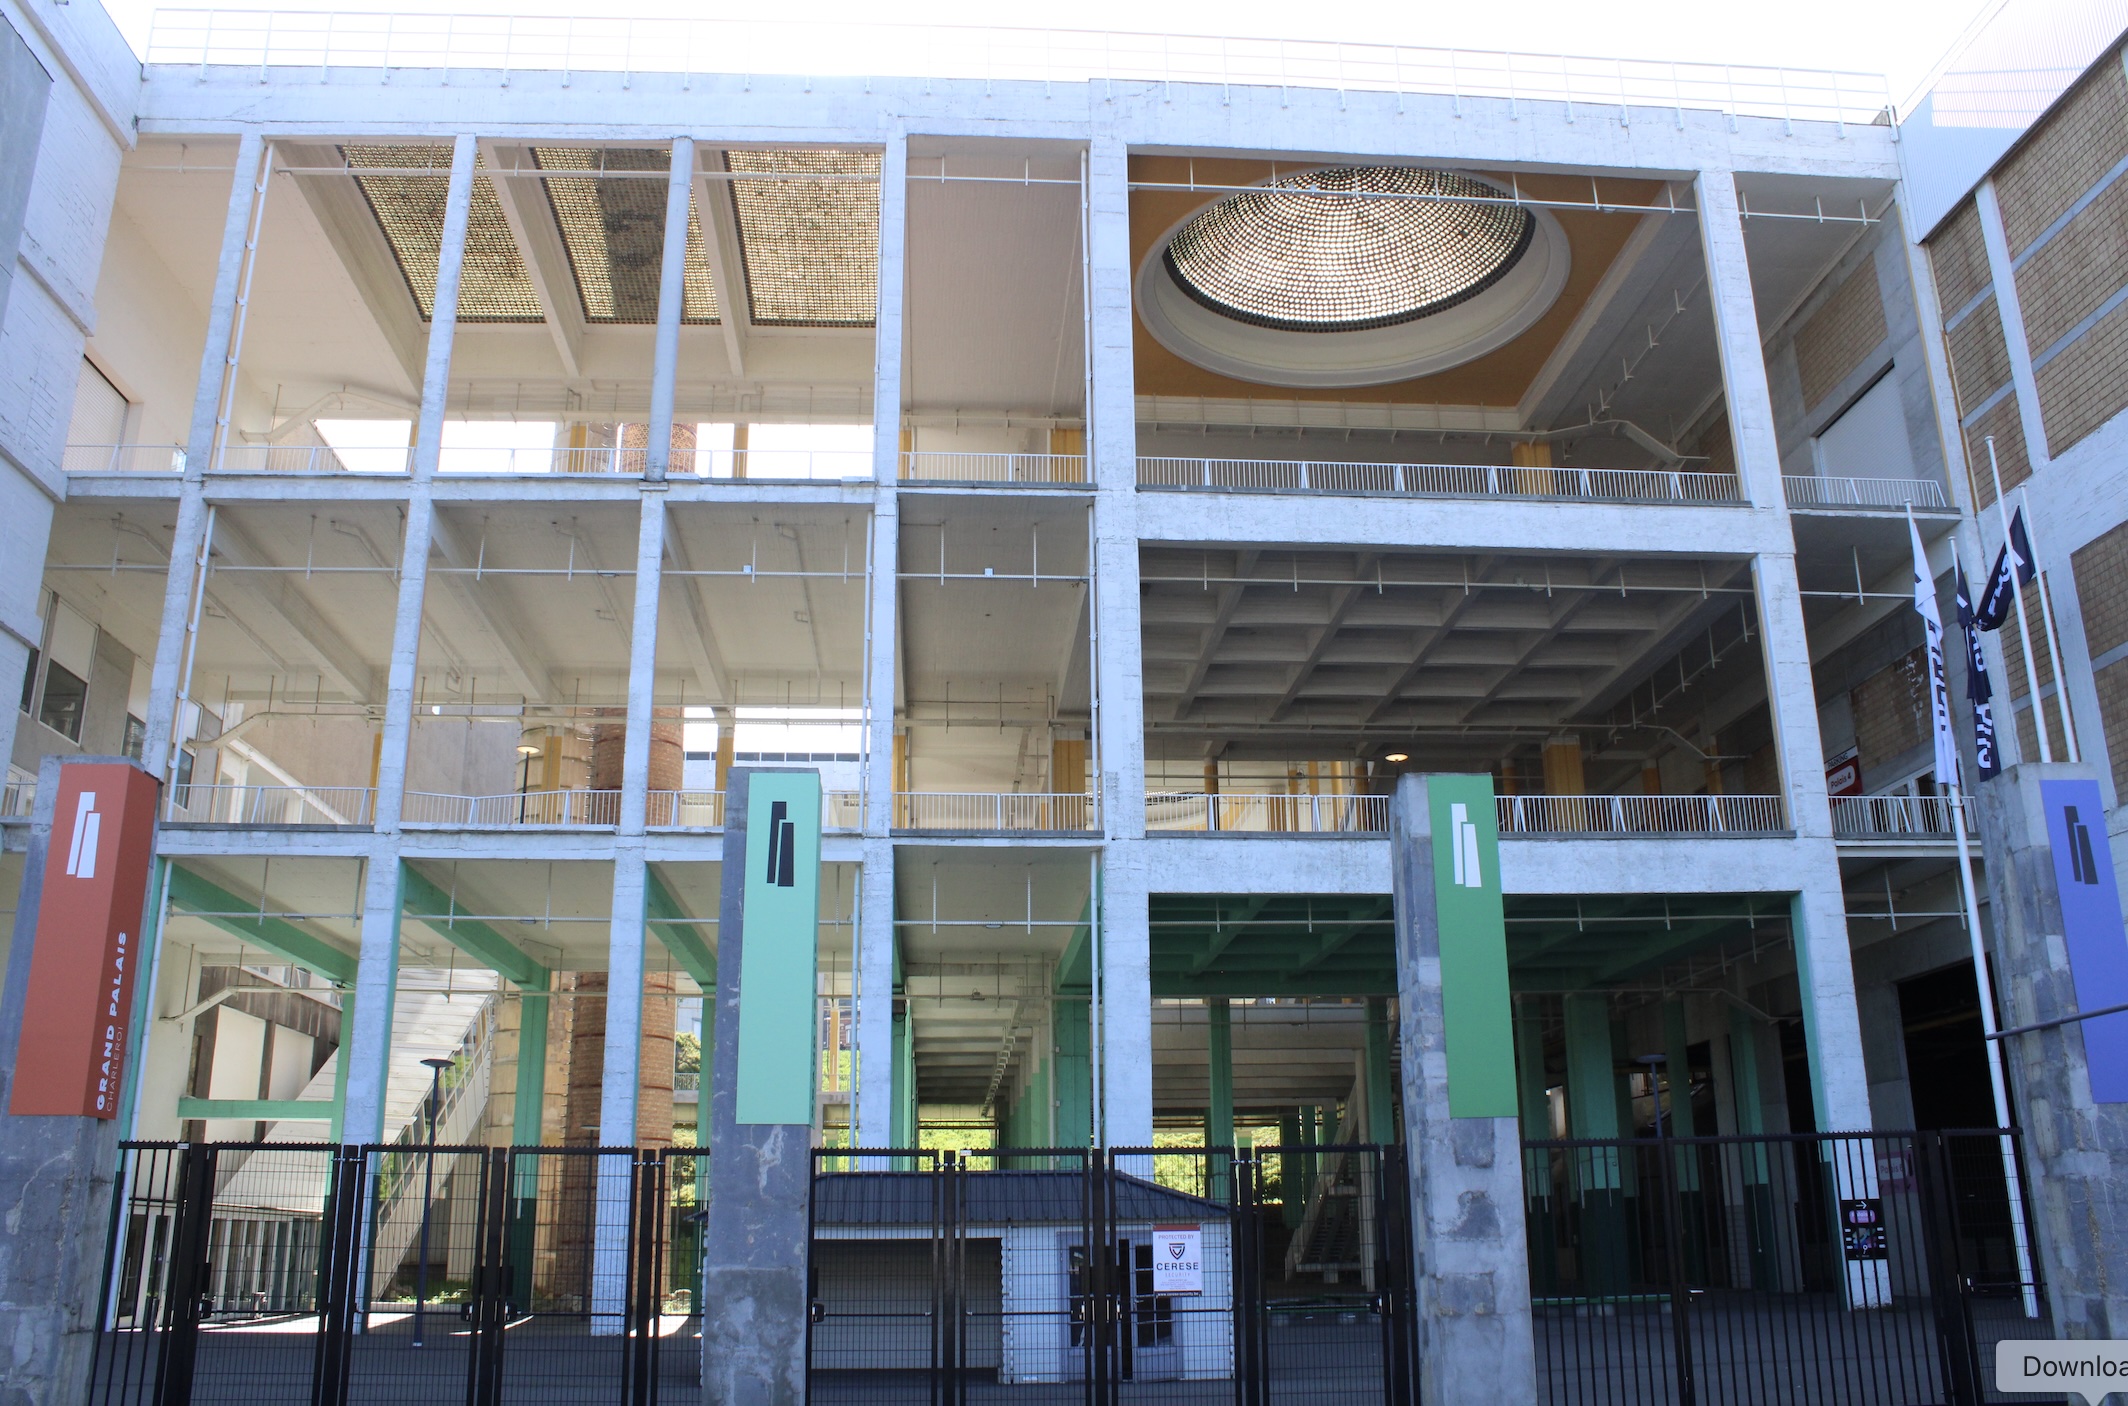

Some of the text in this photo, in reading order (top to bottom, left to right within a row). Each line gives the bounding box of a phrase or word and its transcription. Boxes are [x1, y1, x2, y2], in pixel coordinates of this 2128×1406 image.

[1828, 752, 1848, 769] PARKING
[1830, 775, 1847, 789] Palais
[97, 931, 127, 1110] GRAND PALAIS
[106, 1026, 123, 1112] CHARLEROI
[1156, 1262, 1199, 1271] CERESE
